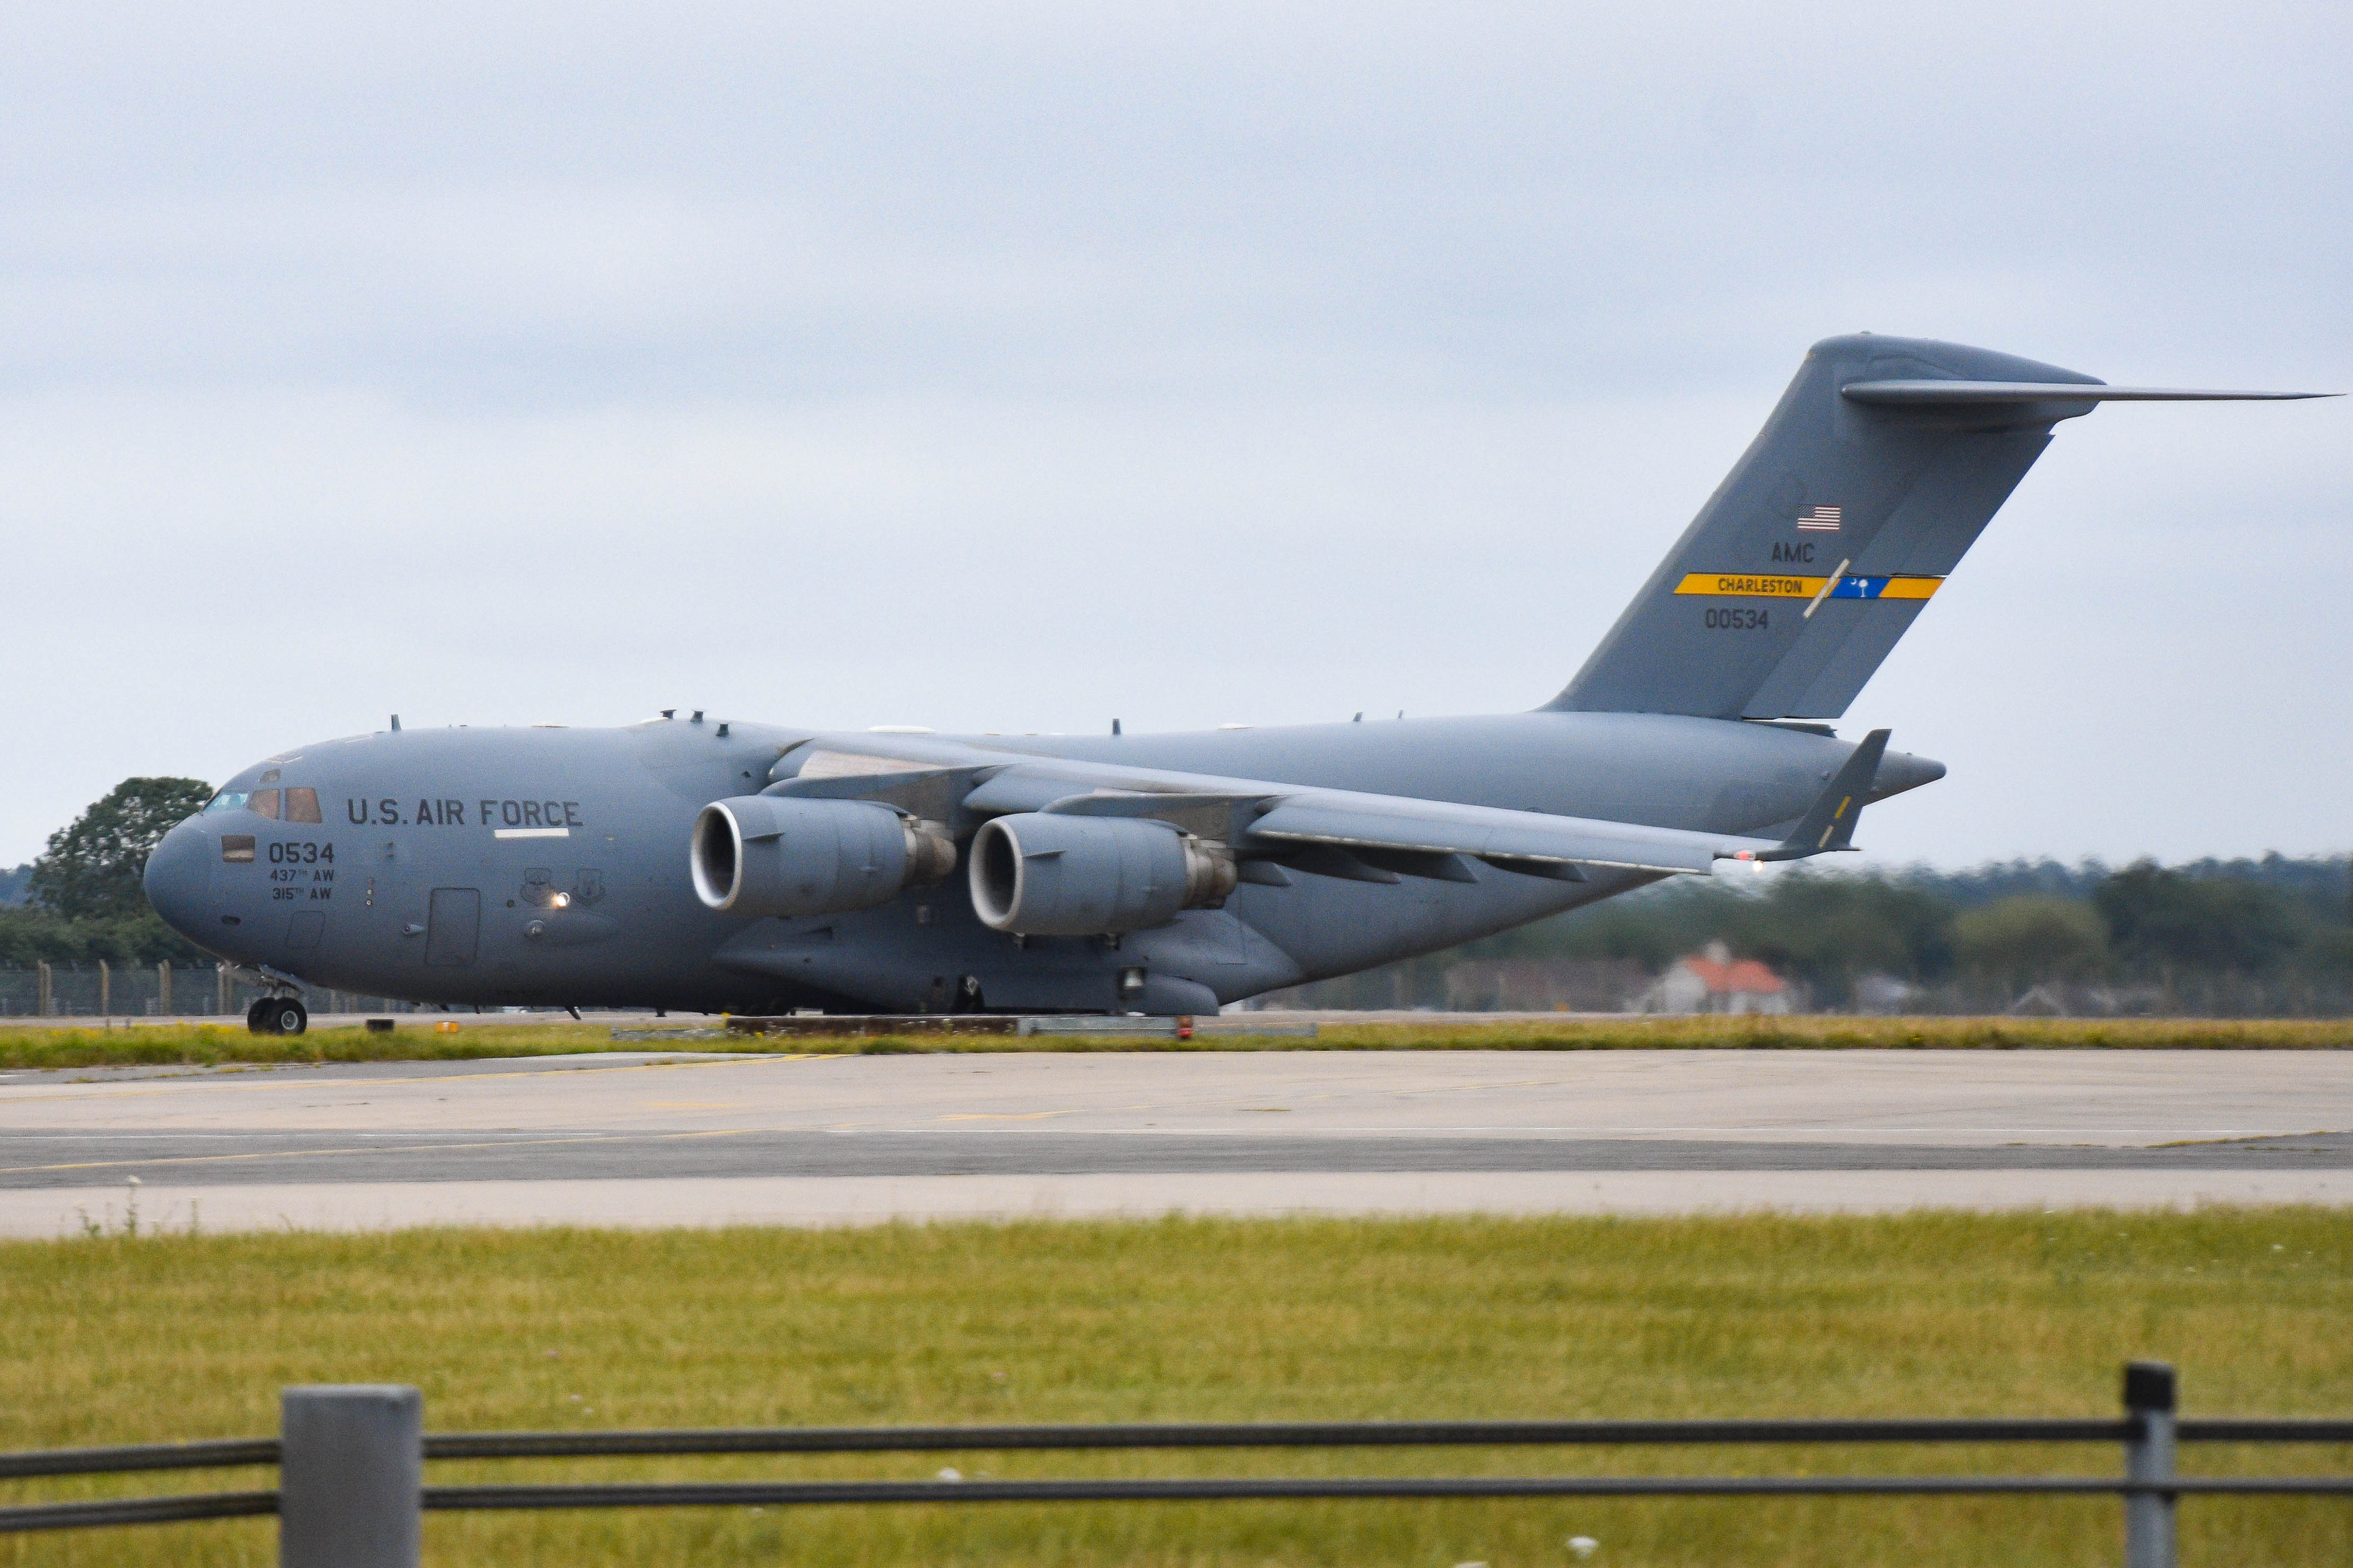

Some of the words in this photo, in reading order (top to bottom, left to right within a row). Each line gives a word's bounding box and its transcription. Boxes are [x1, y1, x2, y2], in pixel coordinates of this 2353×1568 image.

[1772, 542, 1815, 563] AMC
[1718, 578, 1802, 593] CHARLESTON
[1705, 609, 1768, 629] 00534
[348, 798, 408, 825] U.S.
[416, 798, 465, 825] AIR
[480, 799, 584, 827] FORCE
[269, 842, 334, 863] 0534
[313, 869, 334, 882] AW
[310, 887, 331, 899] AW
